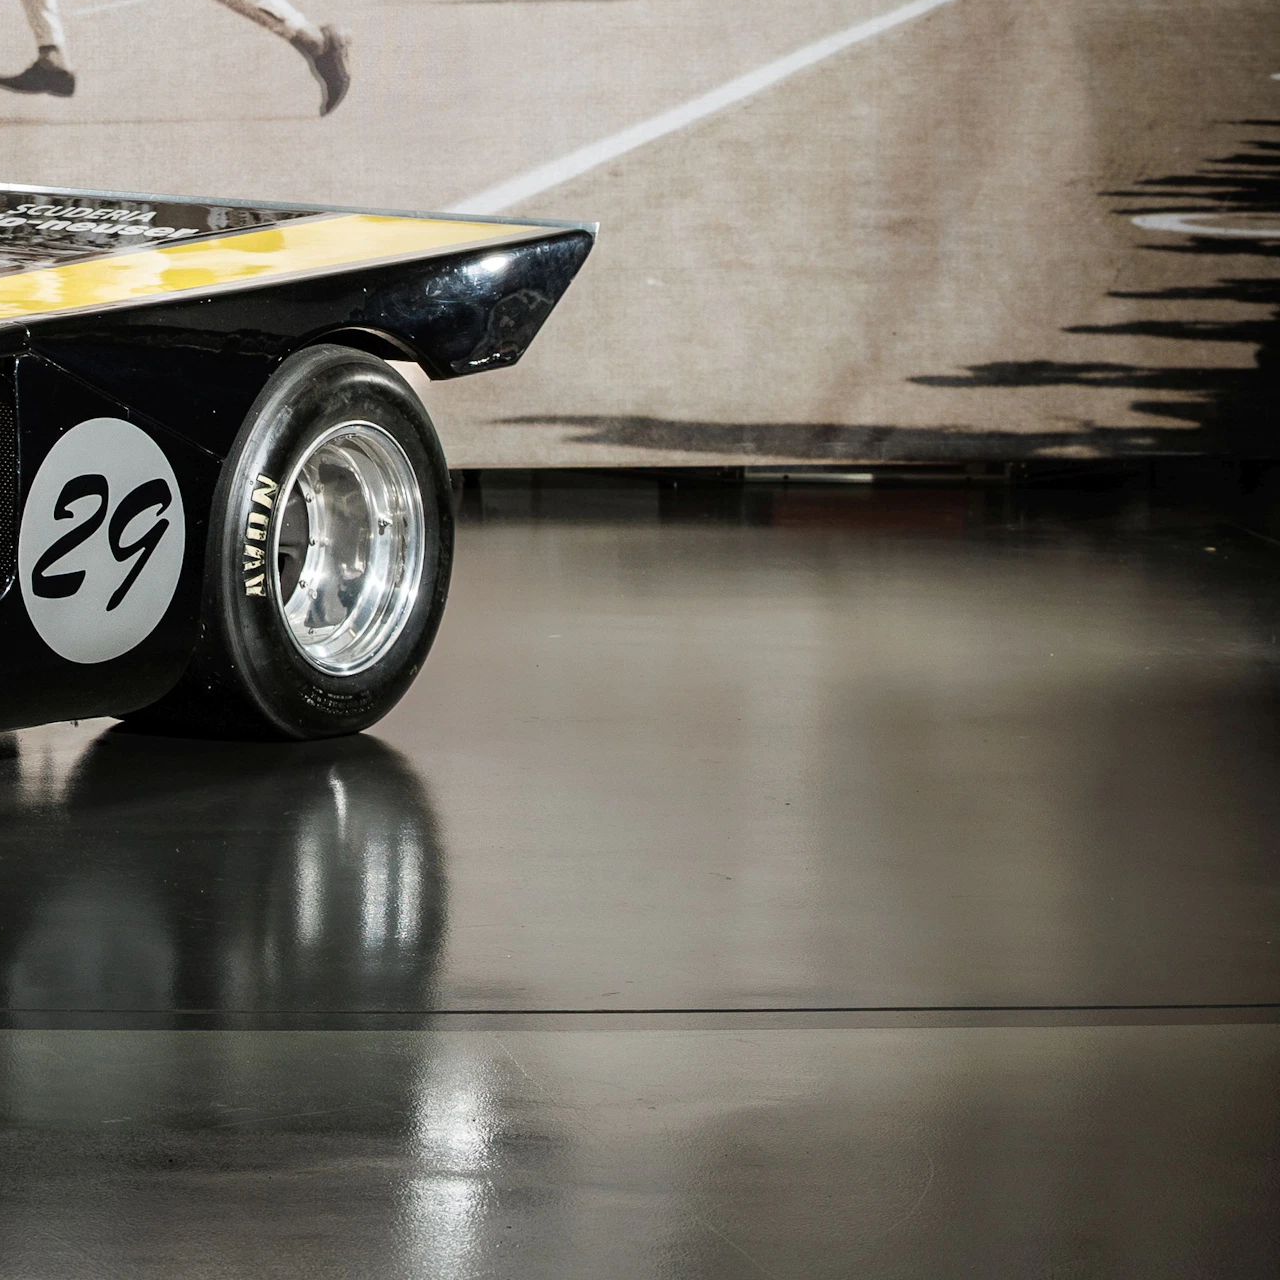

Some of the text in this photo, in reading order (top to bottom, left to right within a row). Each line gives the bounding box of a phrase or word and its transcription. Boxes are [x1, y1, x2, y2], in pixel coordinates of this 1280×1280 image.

[6, 203, 158, 223] SCUDERIA
[31, 473, 173, 612] 29
[243, 473, 278, 597] AVON
